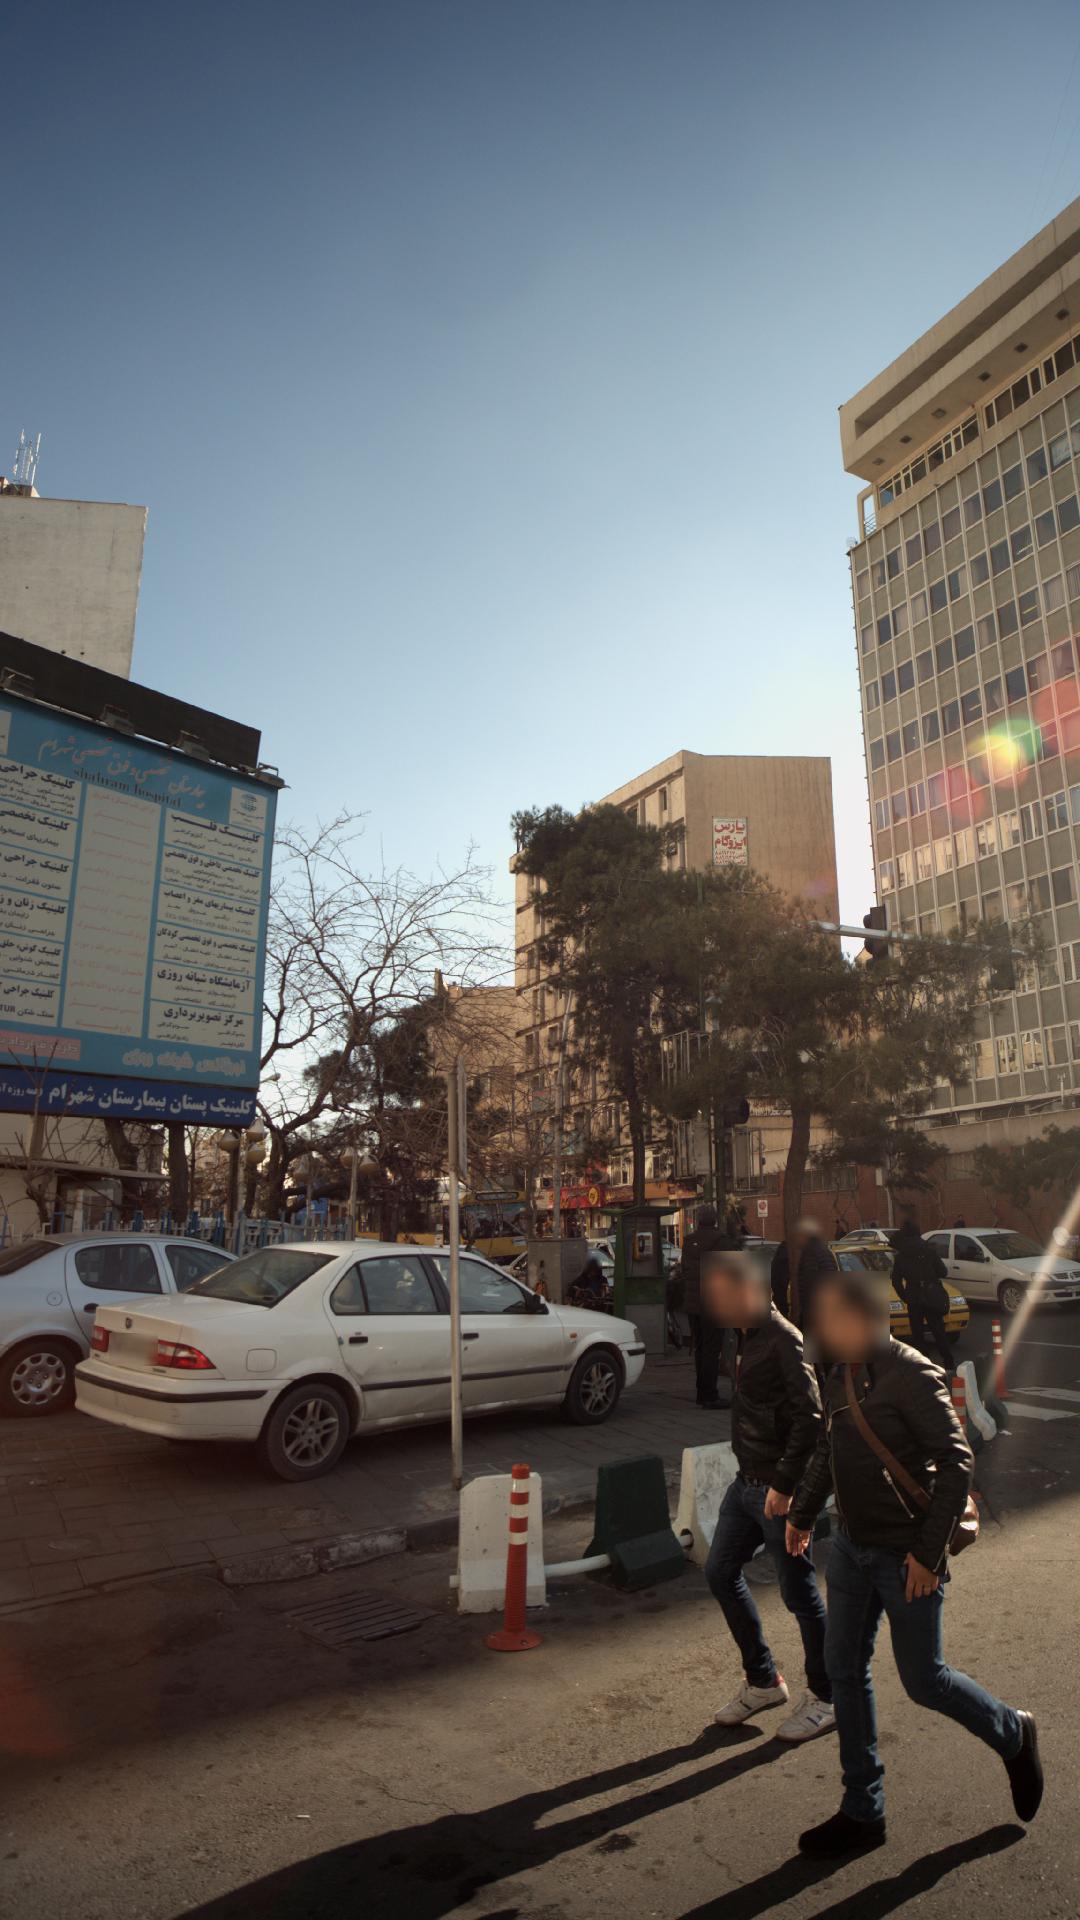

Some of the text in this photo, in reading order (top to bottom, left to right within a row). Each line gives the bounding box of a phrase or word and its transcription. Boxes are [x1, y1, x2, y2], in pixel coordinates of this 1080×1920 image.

[41, 774, 75, 789] کلینیک
[73, 766, 130, 792] shahram
[134, 783, 182, 808] hospital
[38, 817, 70, 831] کلینیک
[171, 814, 217, 831] قلب
[714, 819, 746, 834] پارس
[219, 826, 260, 844] کلینیک
[714, 834, 747, 849] ایزوگام
[4, 854, 69, 873] کلینیک جراحی
[243, 868, 260, 878] کلینیک
[7, 898, 12, 906] و
[164, 890, 186, 901] اعصاب
[14, 897, 34, 910] زنان
[36, 902, 66, 915] کلینیک
[234, 906, 255, 916] کلینیک
[38, 946, 61, 957] کلینیک
[238, 943, 255, 953] کلینیک
[157, 967, 183, 982] روزی
[185, 970, 207, 984] شبانه
[3, 984, 29, 997] جراحی
[209, 975, 251, 993] آزمایشگاه
[31, 987, 55, 1000] کلینیک
[163, 1007, 244, 1027] مرکز تصویربرداری
[122, 1048, 246, 1076] اورژانس شبانه روزی
[8, 1086, 25, 1097] روزه
[48, 1083, 96, 1106] شهرام
[98, 1087, 167, 1112] بیمارستان
[169, 1093, 207, 1116] پستان
[210, 1098, 253, 1117] کلینیک
